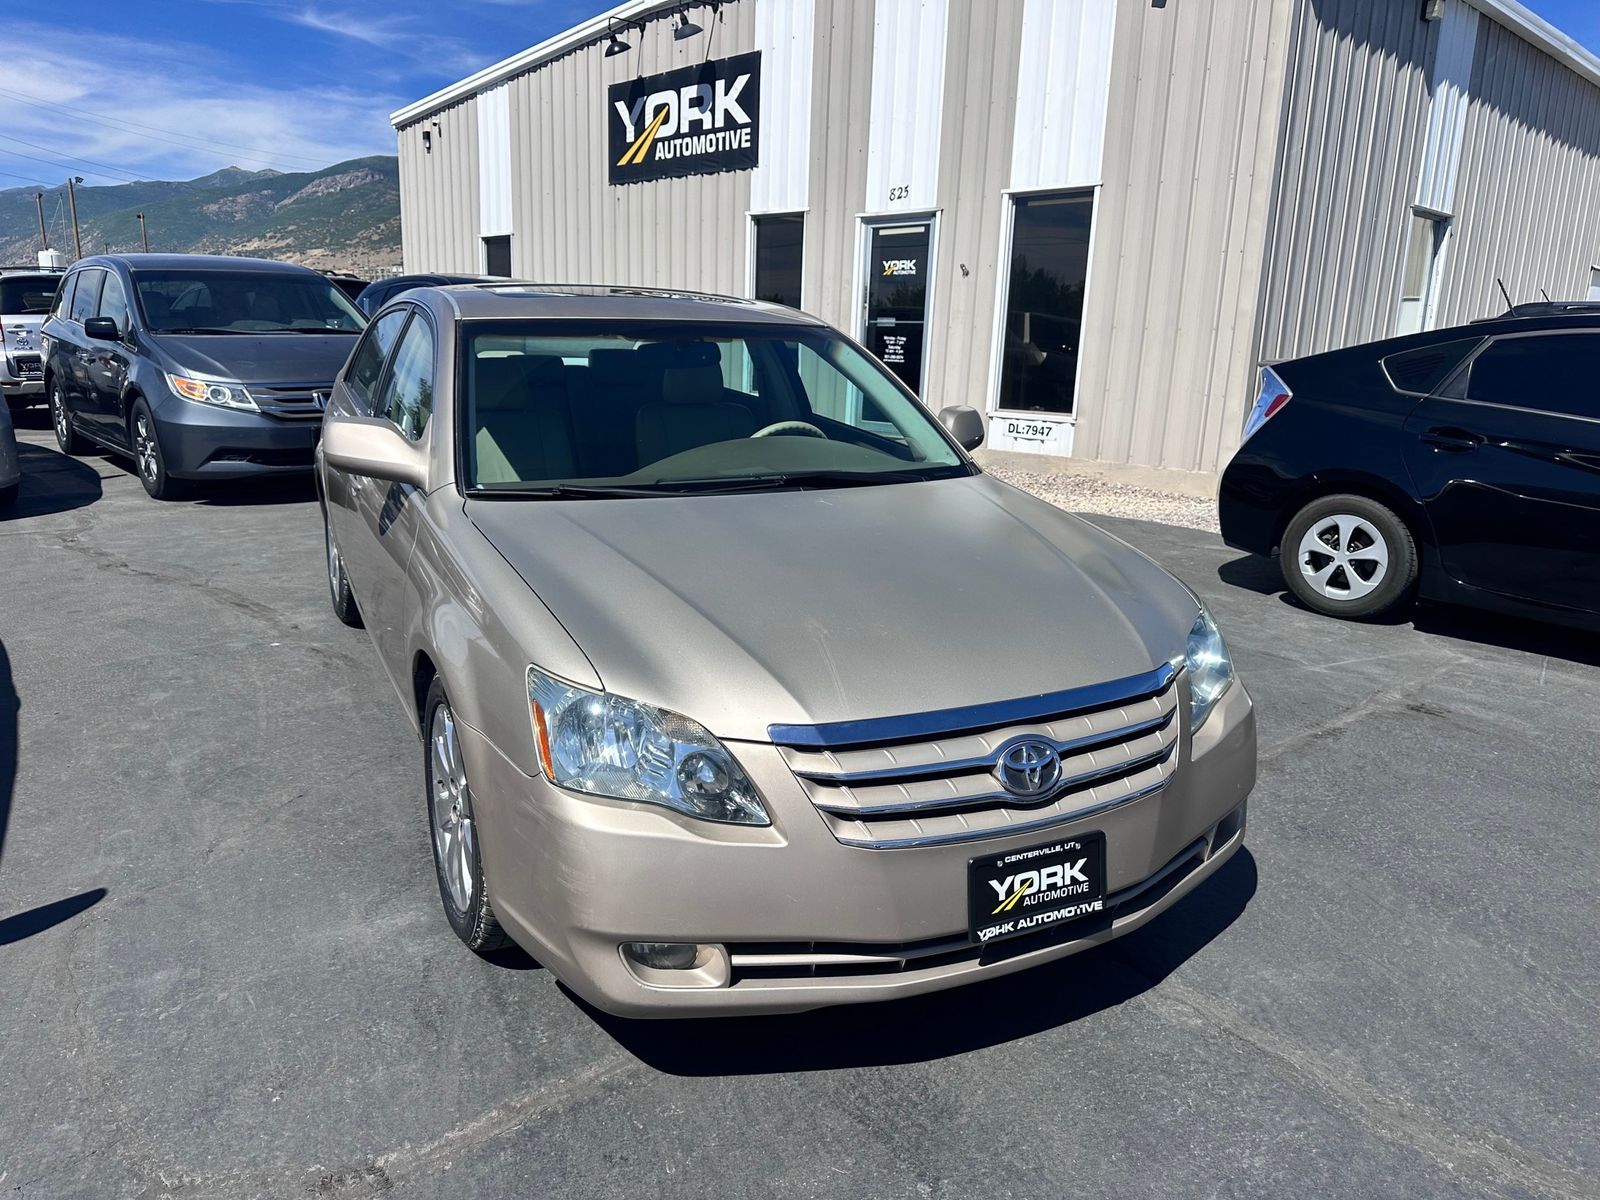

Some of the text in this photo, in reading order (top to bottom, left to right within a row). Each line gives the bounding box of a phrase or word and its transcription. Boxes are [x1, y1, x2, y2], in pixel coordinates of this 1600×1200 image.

[614, 73, 752, 143] YORK
[654, 127, 752, 160] AUTOMOTIVE
[889, 184, 909, 201] 825
[882, 259, 917, 271] YORK
[1008, 423, 1053, 437] DL:7947
[1004, 841, 1076, 864] CENTERVILLE, UT
[988, 857, 1089, 902] YORK
[1023, 882, 1090, 907] AUTOMOTIVE
